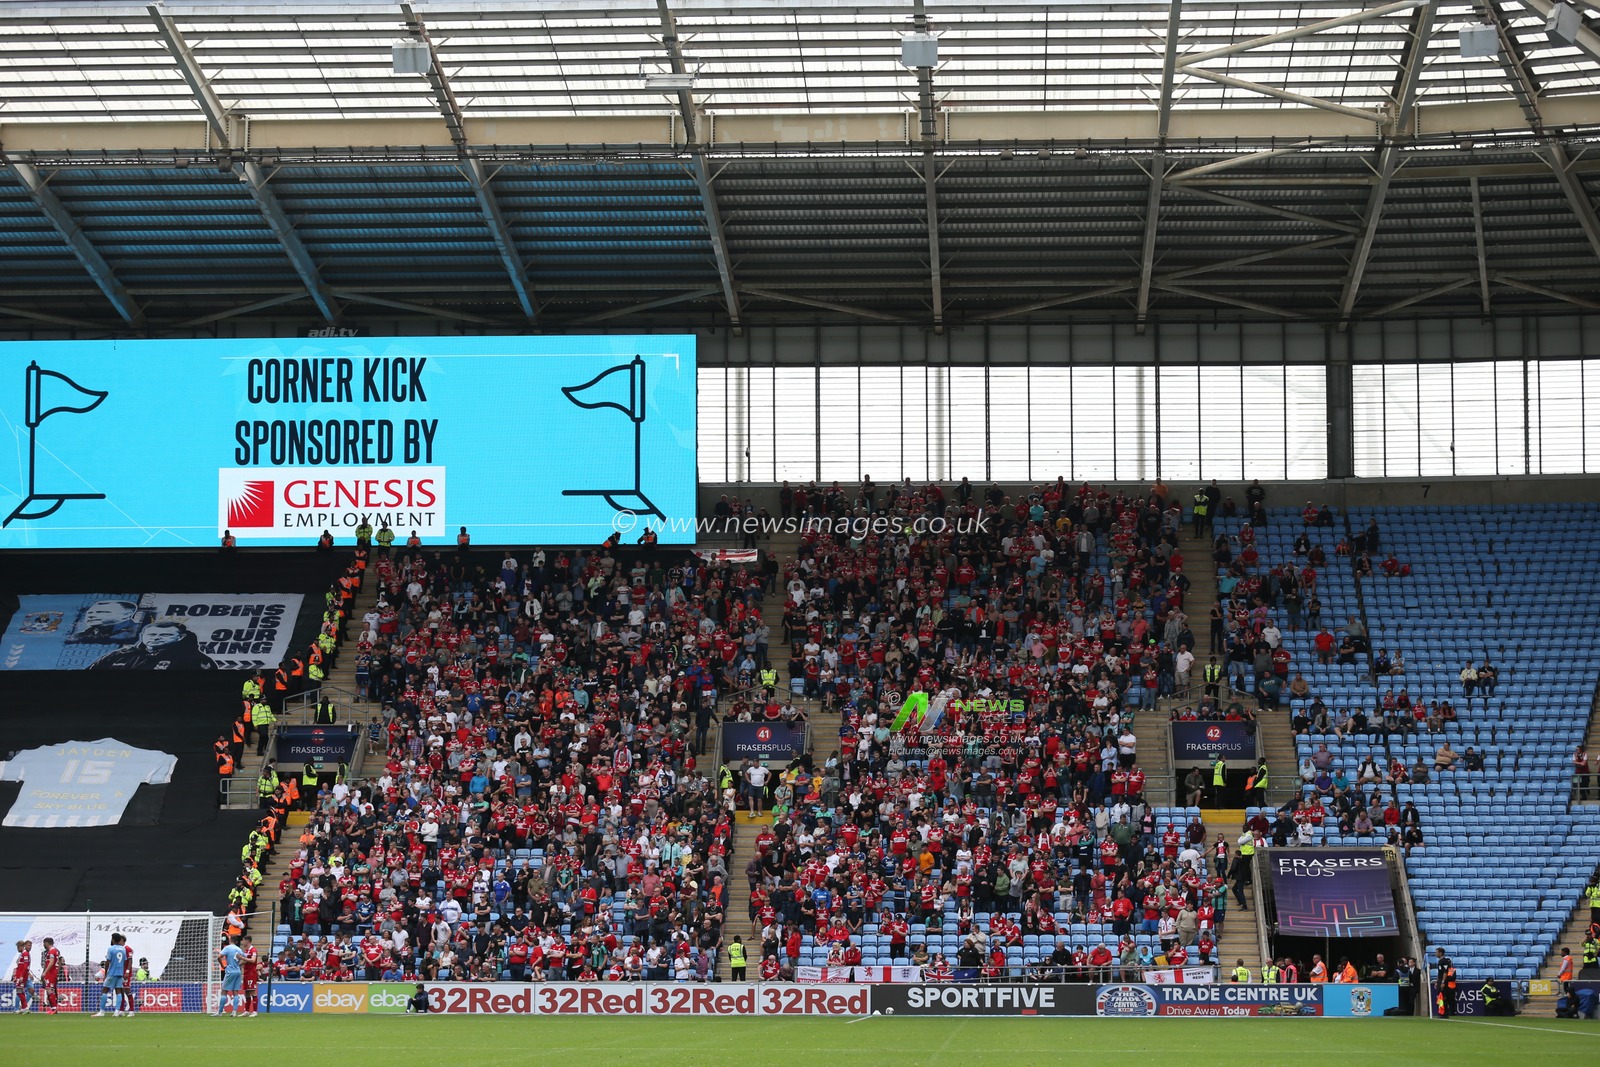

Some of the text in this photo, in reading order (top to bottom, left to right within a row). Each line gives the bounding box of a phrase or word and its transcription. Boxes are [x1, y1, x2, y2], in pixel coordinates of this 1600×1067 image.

[307, 327, 358, 338] adi.tv
[247, 357, 427, 404] CORNER KICK
[235, 419, 438, 465] SPONSORED BY
[283, 479, 436, 508] GENESIS
[1421, 485, 1430, 498] 7
[284, 512, 436, 527] EMPLOYMENT
[165, 604, 286, 616] ROBINS
[248, 616, 282, 629] IS
[211, 629, 278, 641] OUR
[199, 642, 274, 654] KING
[759, 730, 769, 738] 41
[1207, 729, 1220, 738] 42
[57, 748, 132, 758] JAYDEN
[291, 746, 346, 754] FRASERSPLUS
[736, 744, 792, 752] FRASERSPLUS
[1186, 743, 1242, 751] FRASERSPLUS
[59, 760, 115, 784] 15
[30, 790, 100, 800] FOREVER
[1279, 858, 1383, 868] FRASERS
[1280, 867, 1335, 877] PLUS
[94, 924, 149, 933] MAGIC
[116, 952, 122, 963] 9
[143, 988, 178, 1007] bet
[260, 989, 309, 1010] ebay
[315, 989, 365, 1010] ebay
[370, 989, 411, 1007] eba
[427, 988, 531, 1013] 32Red
[538, 988, 643, 1013] 32Red
[650, 988, 755, 1013] 32Red
[907, 987, 1055, 1008] SPORTFIVE
[1162, 987, 1318, 1001] TRADE CENTRE UK
[762, 988, 868, 1014] 32Red
[1166, 1006, 1250, 1016] Drive Away Today
